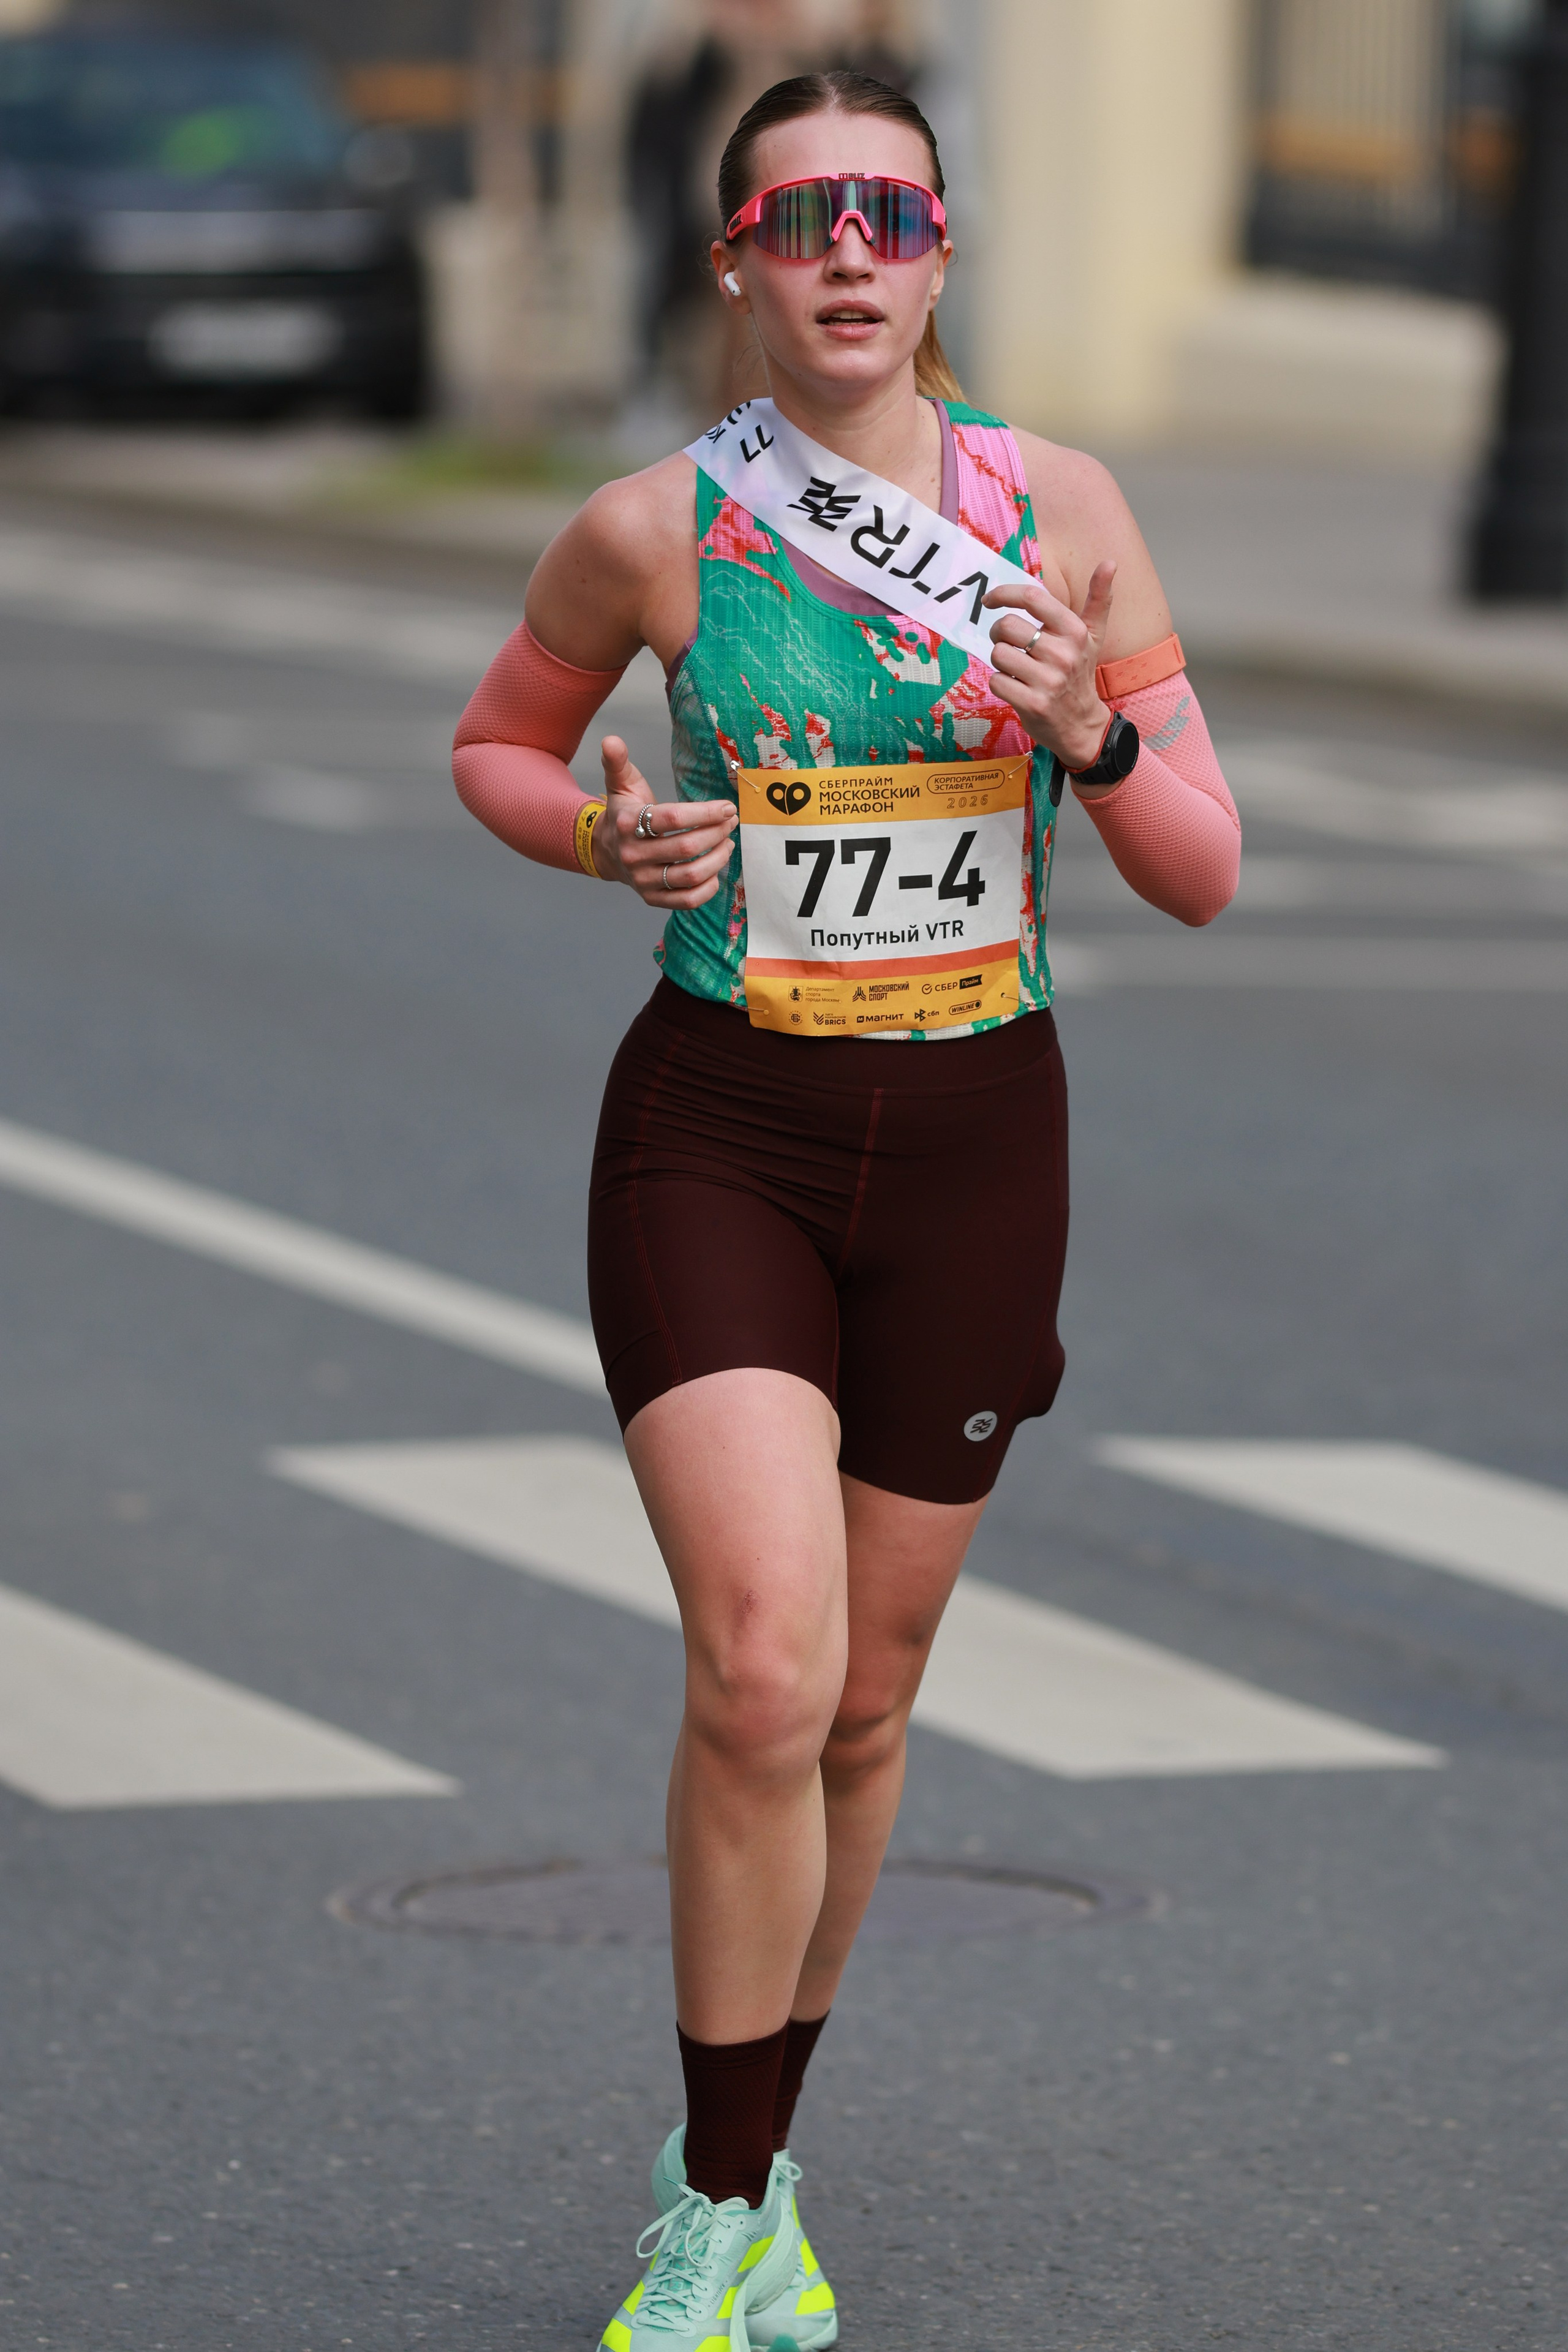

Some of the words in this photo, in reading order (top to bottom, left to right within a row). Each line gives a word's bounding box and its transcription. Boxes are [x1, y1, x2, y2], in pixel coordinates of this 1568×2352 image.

[739, 424, 774, 464] 77
[850, 504, 989, 625] VTR
[819, 775, 894, 789] СБЕРПРАЙМ
[934, 772, 999, 784] КОРПОРАТИВНАЯ
[819, 785, 920, 802] МОСКОВСКИЙ
[820, 801, 894, 815] МАРАФОН
[946, 794, 989, 809] 2026
[785, 830, 986, 918] 77-4
[810, 924, 919, 950] Попутный
[925, 919, 965, 941] VTR
[869, 981, 910, 993] МОСКОВСКИЙ
[935, 982, 958, 992] СБЕР
[961, 978, 979, 987] Прайм
[869, 992, 888, 1001] СПОРТ
[951, 1003, 975, 1013] WINLINE
